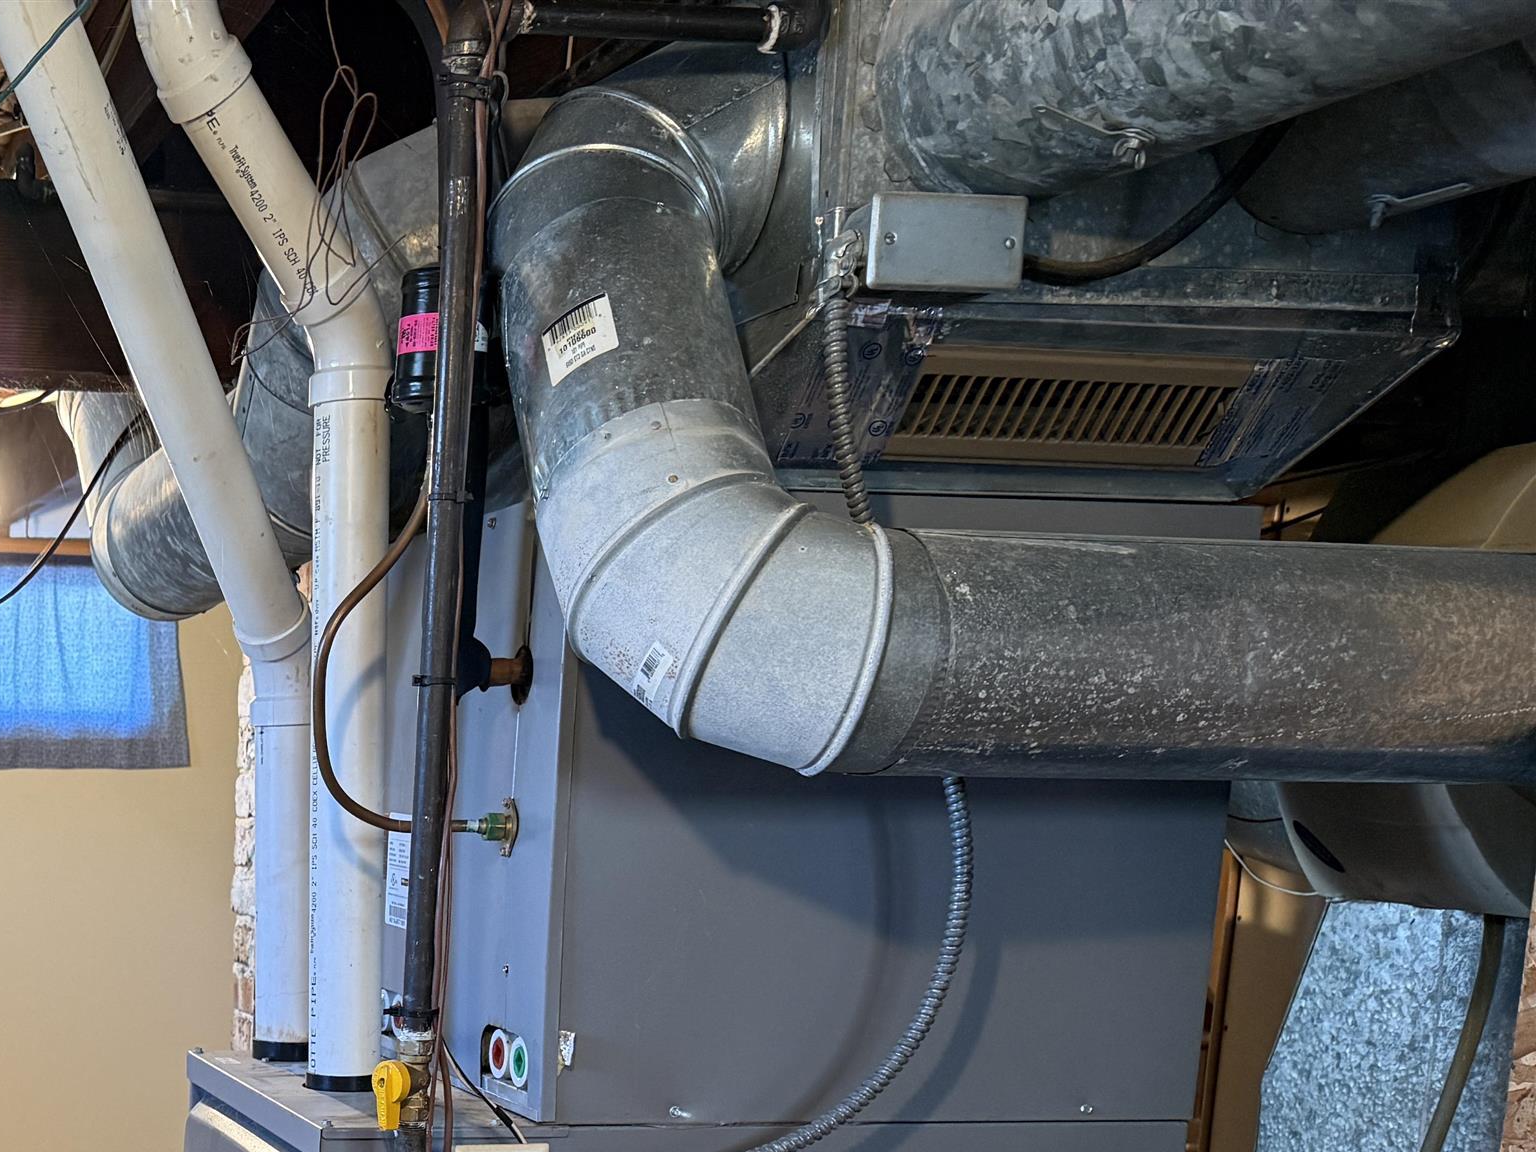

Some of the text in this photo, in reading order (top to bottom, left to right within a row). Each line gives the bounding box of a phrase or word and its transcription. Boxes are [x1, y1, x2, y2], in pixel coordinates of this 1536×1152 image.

[249, 190, 268, 214] 4200
[272, 228, 288, 247] IPS
[284, 247, 300, 266] SCH
[322, 414, 331, 463] PRESSURE
